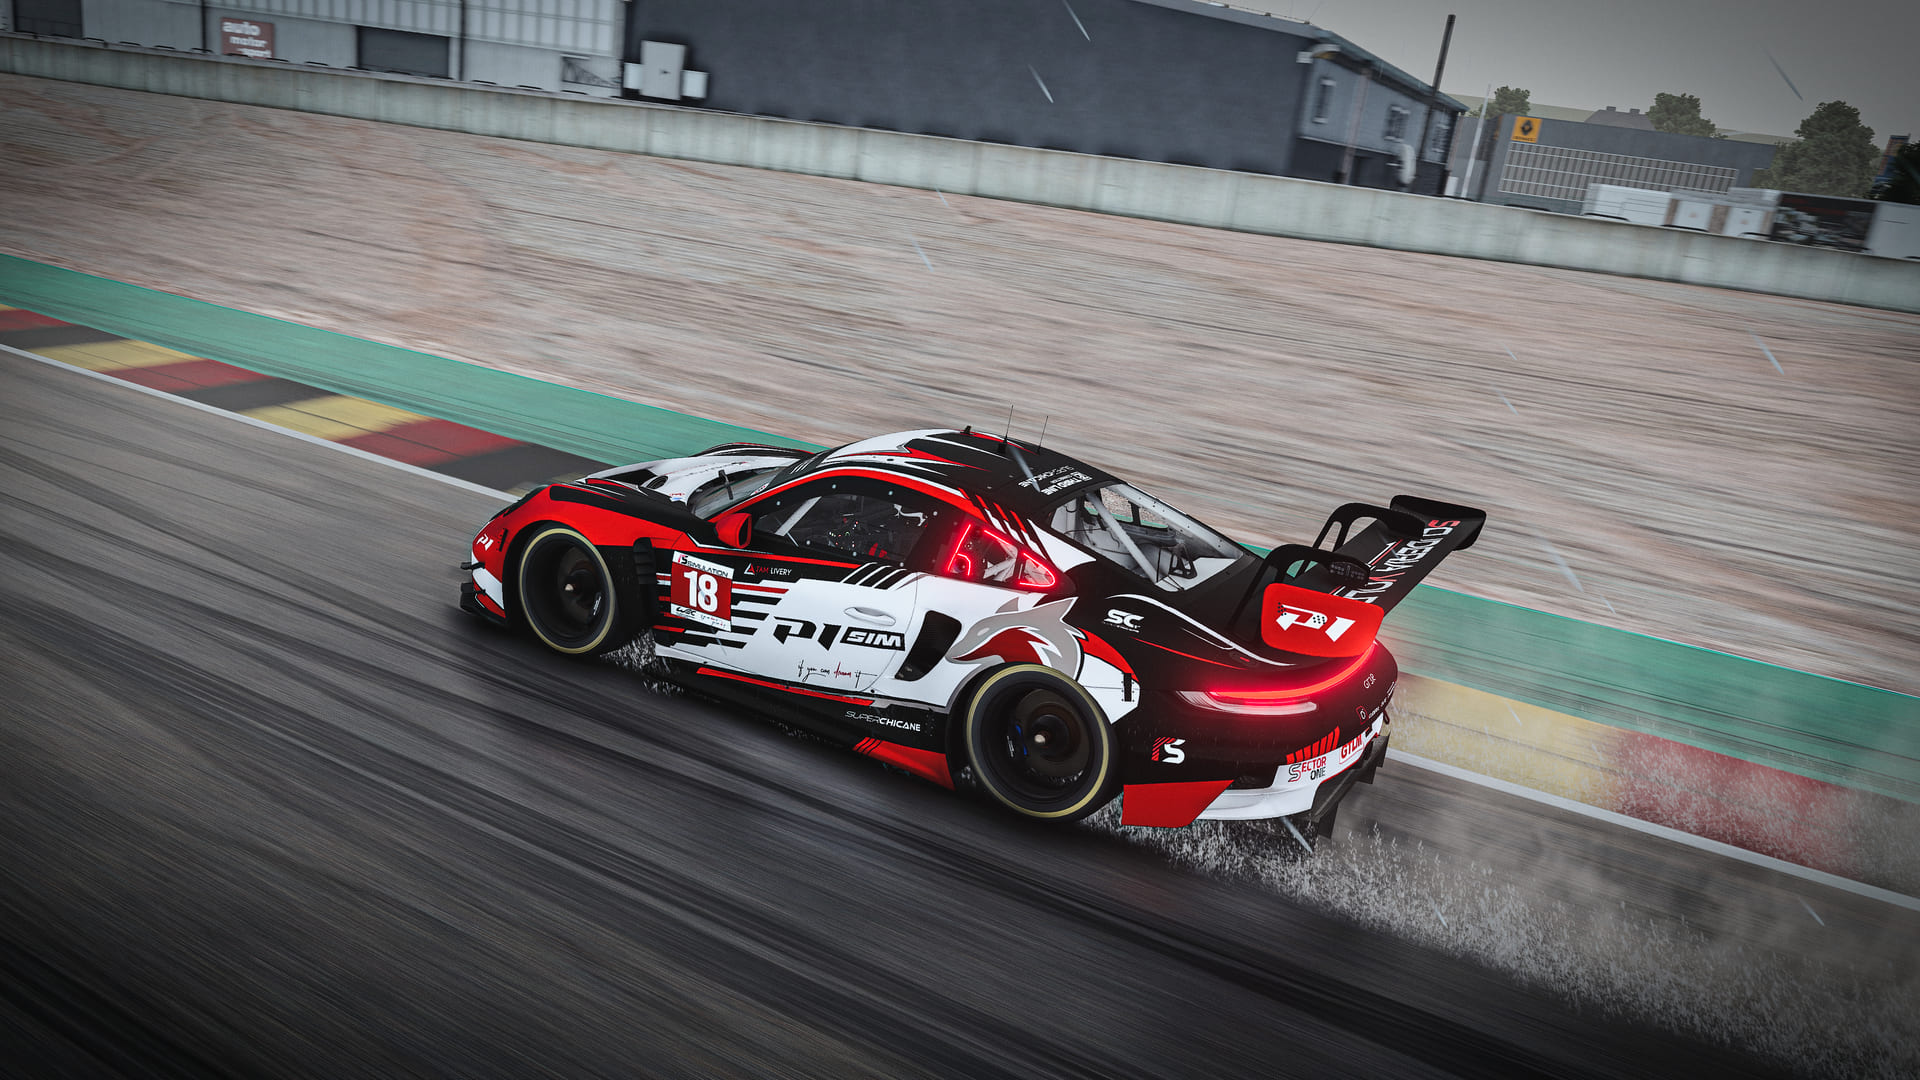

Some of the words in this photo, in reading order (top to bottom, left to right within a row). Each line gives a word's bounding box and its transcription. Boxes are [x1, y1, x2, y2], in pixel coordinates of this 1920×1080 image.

[223, 21, 261, 36] auto
[229, 36, 268, 47] motor
[770, 567, 793, 576] LIVERY
[683, 570, 718, 612] 18
[846, 631, 902, 648] SIM
[845, 710, 921, 732] SUPERCHICANE
[1288, 755, 1327, 783] SECTOR
[1310, 767, 1326, 781] ONE
